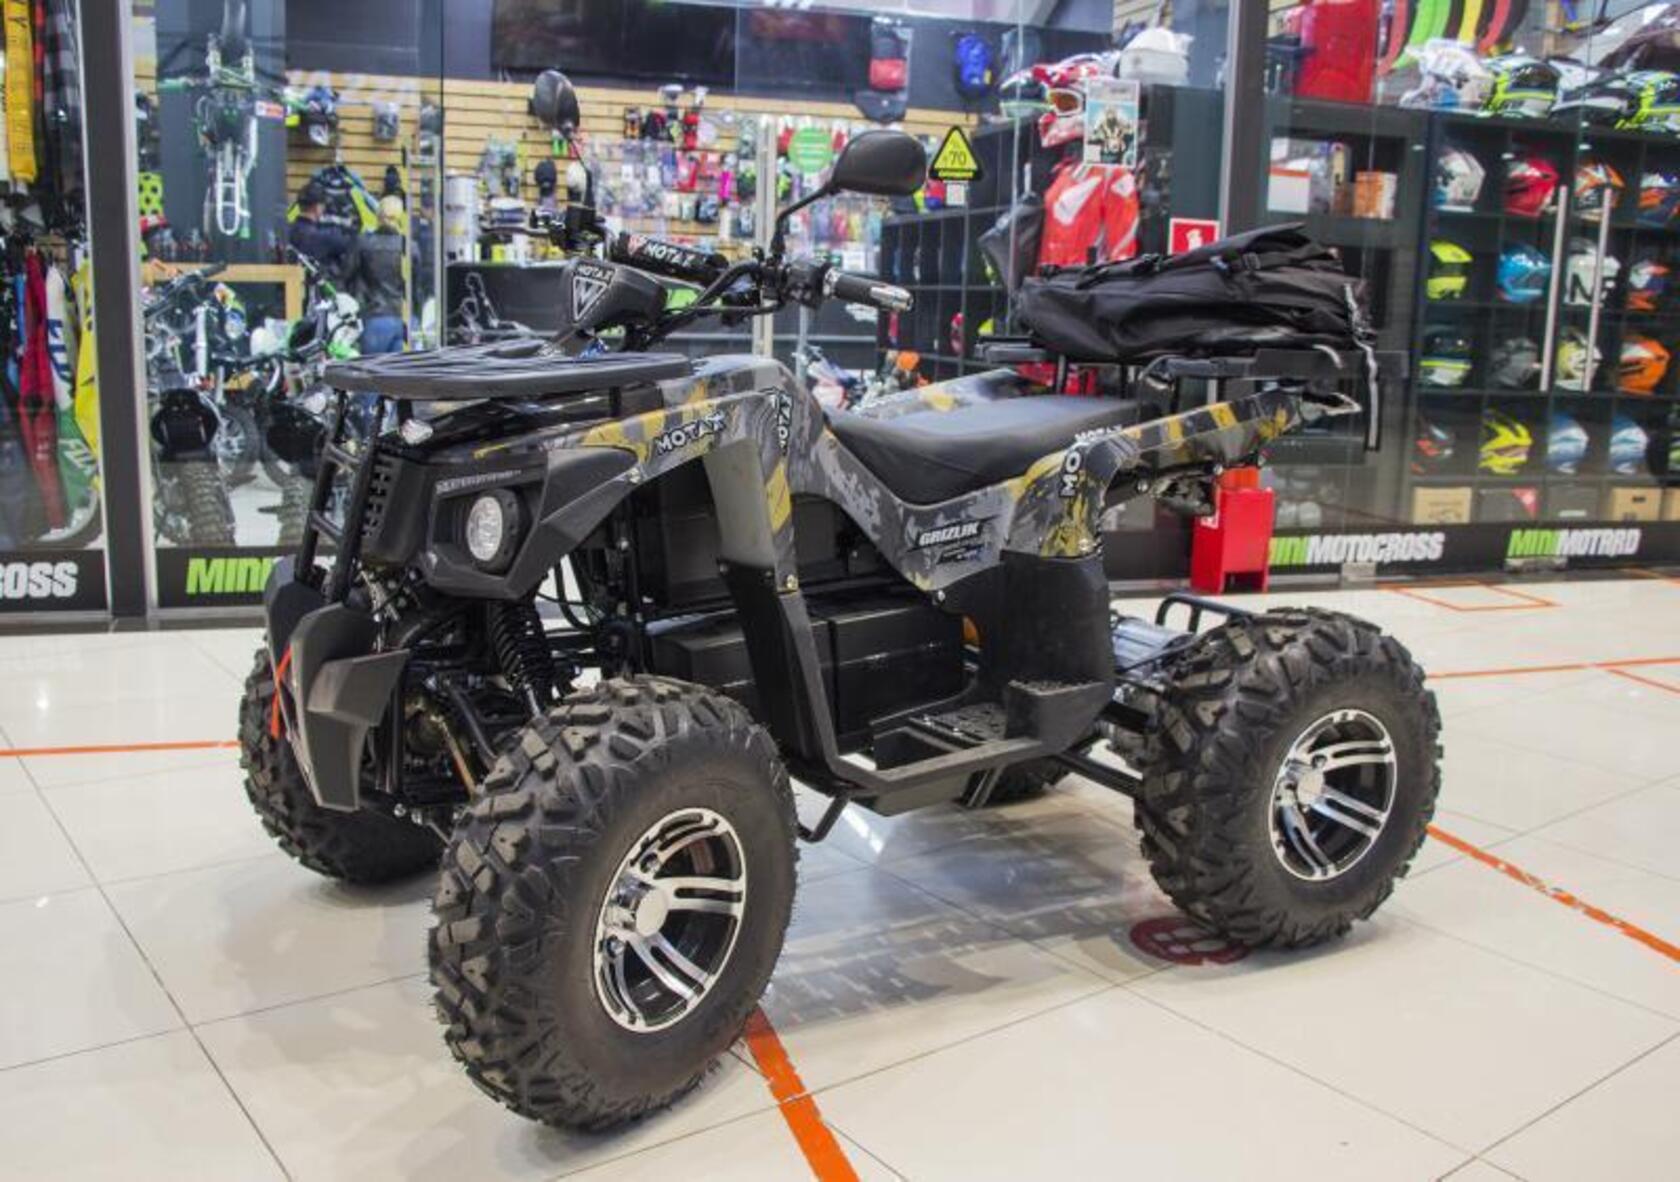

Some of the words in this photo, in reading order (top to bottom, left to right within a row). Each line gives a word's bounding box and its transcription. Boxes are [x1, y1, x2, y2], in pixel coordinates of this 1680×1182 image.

[645, 242, 697, 268] MOTAX
[656, 410, 726, 454] MOTAX
[1269, 532, 1445, 565] INIMOTOCROSS
[0, 562, 78, 599] OSS
